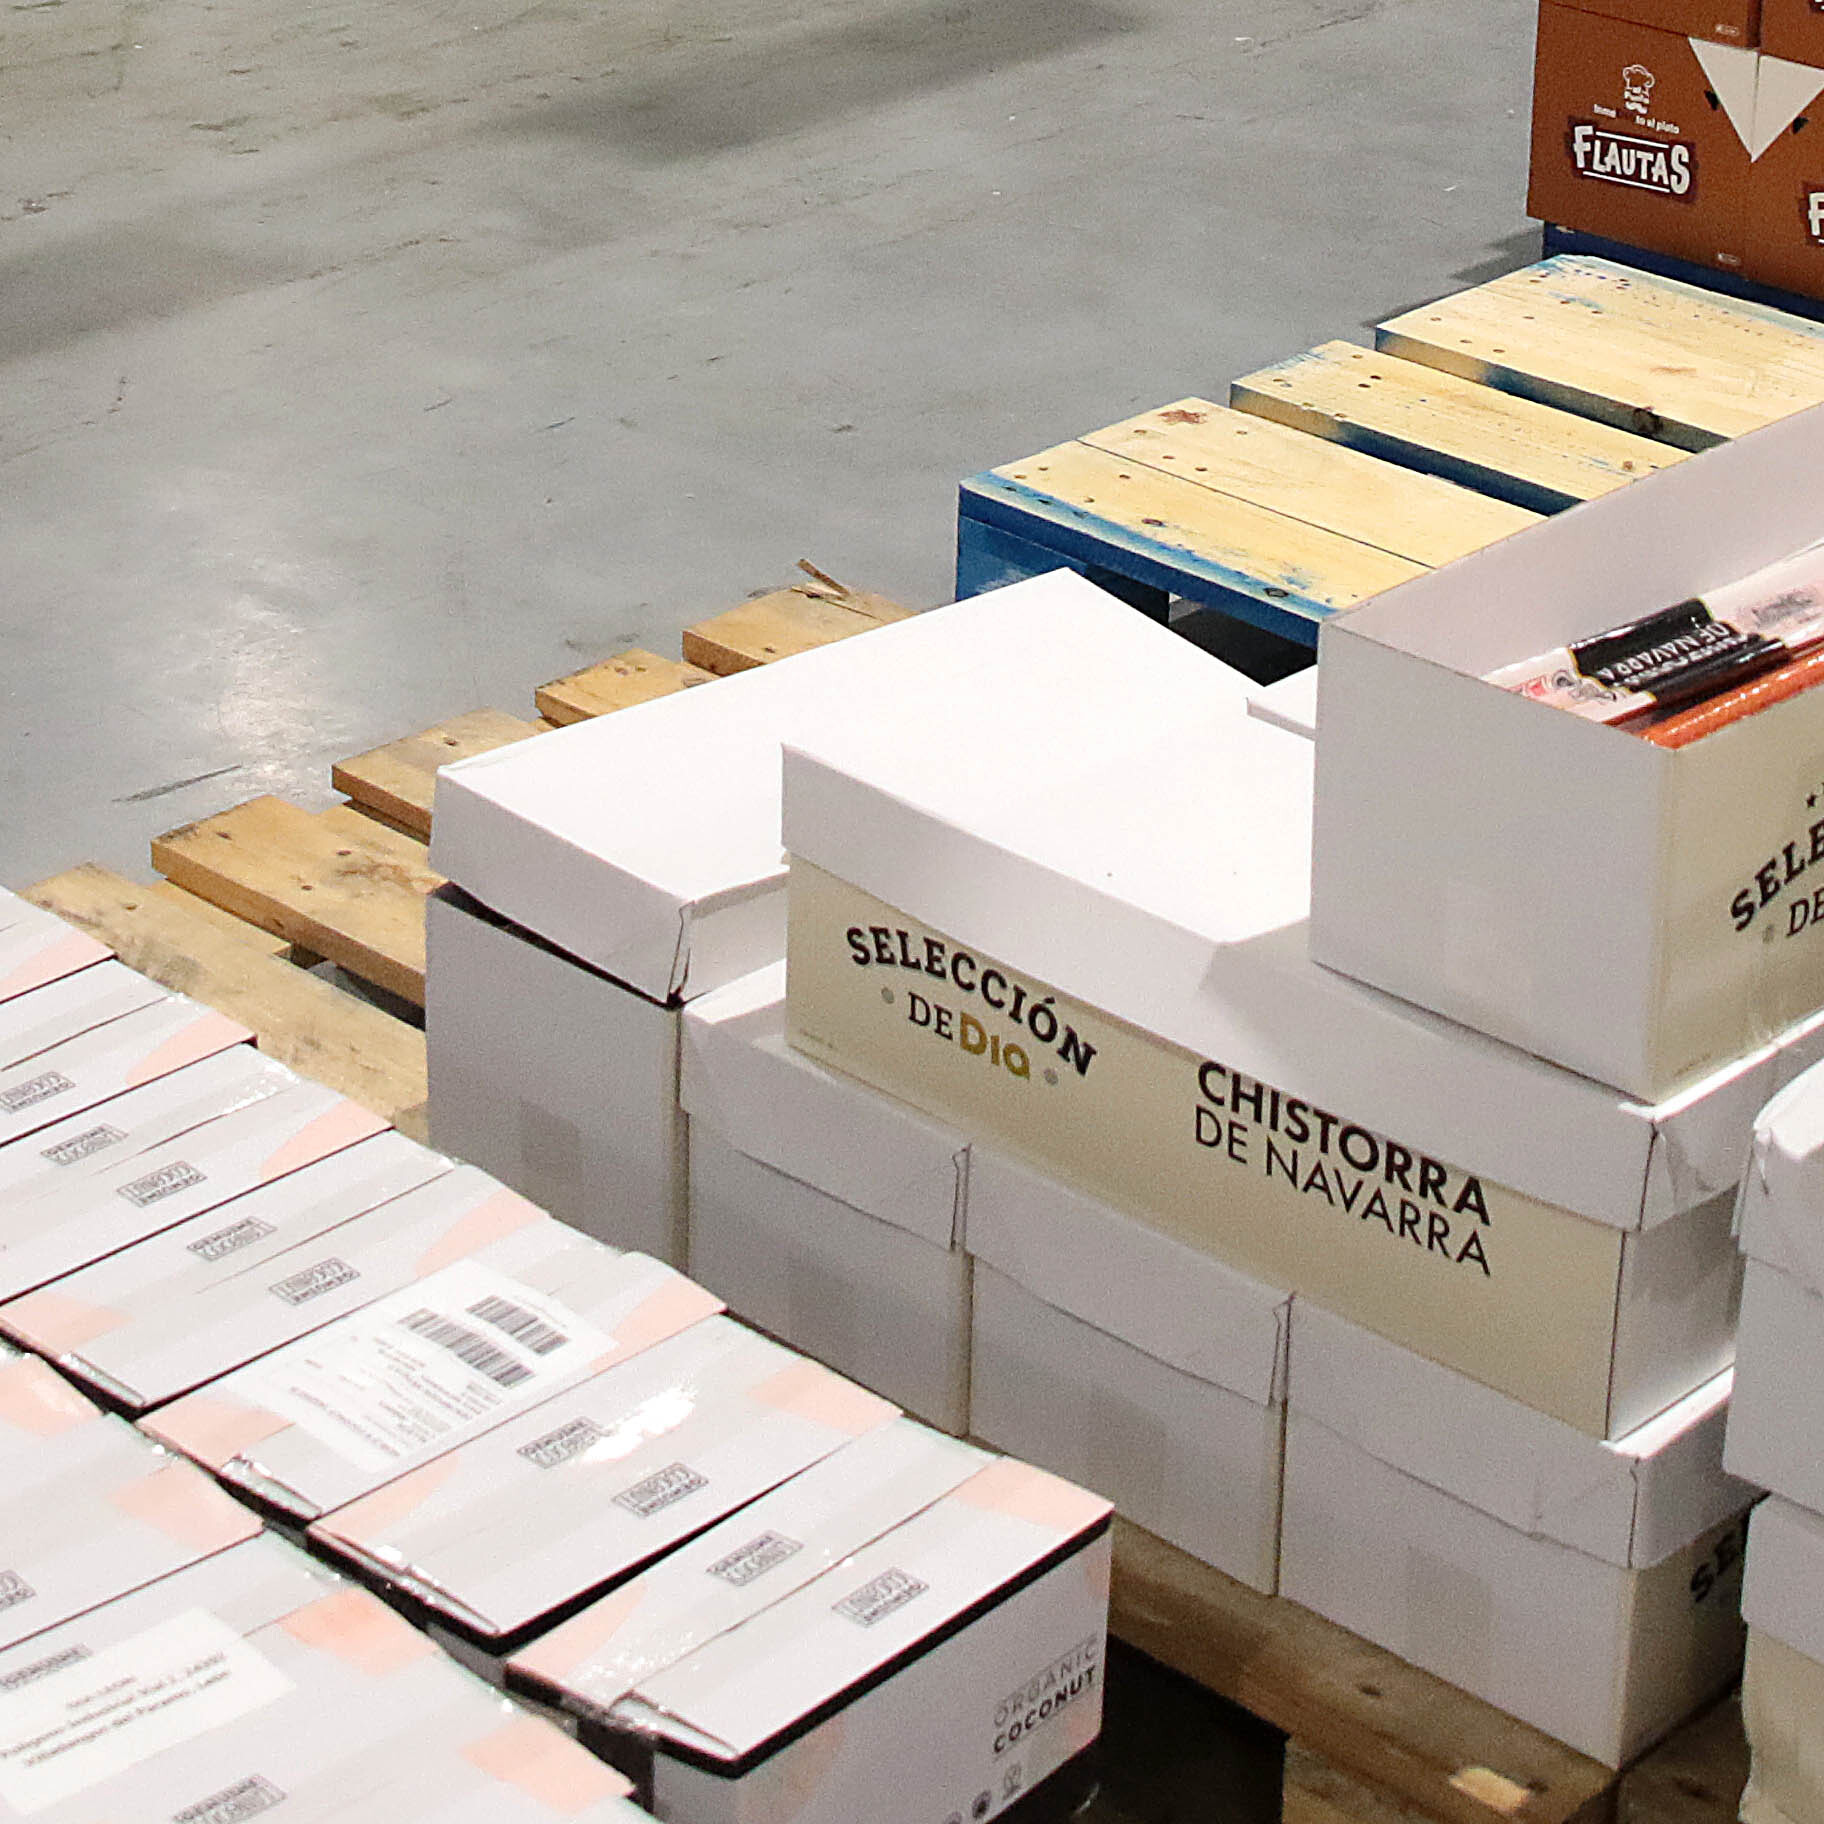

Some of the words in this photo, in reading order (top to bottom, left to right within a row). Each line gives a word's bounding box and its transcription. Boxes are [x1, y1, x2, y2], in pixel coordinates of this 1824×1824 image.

[1574, 125, 1690, 194] FLAUTAS
[846, 923, 1098, 1079] SELECCIÓN
[1196, 1106, 1247, 1163] DE
[1266, 1135, 1491, 1278] NAVARRA
[1197, 1060, 1491, 1226] CHISTORRA
[992, 1633, 1098, 1729] ORGANIC
[993, 1666, 1096, 1754] COCONUT
